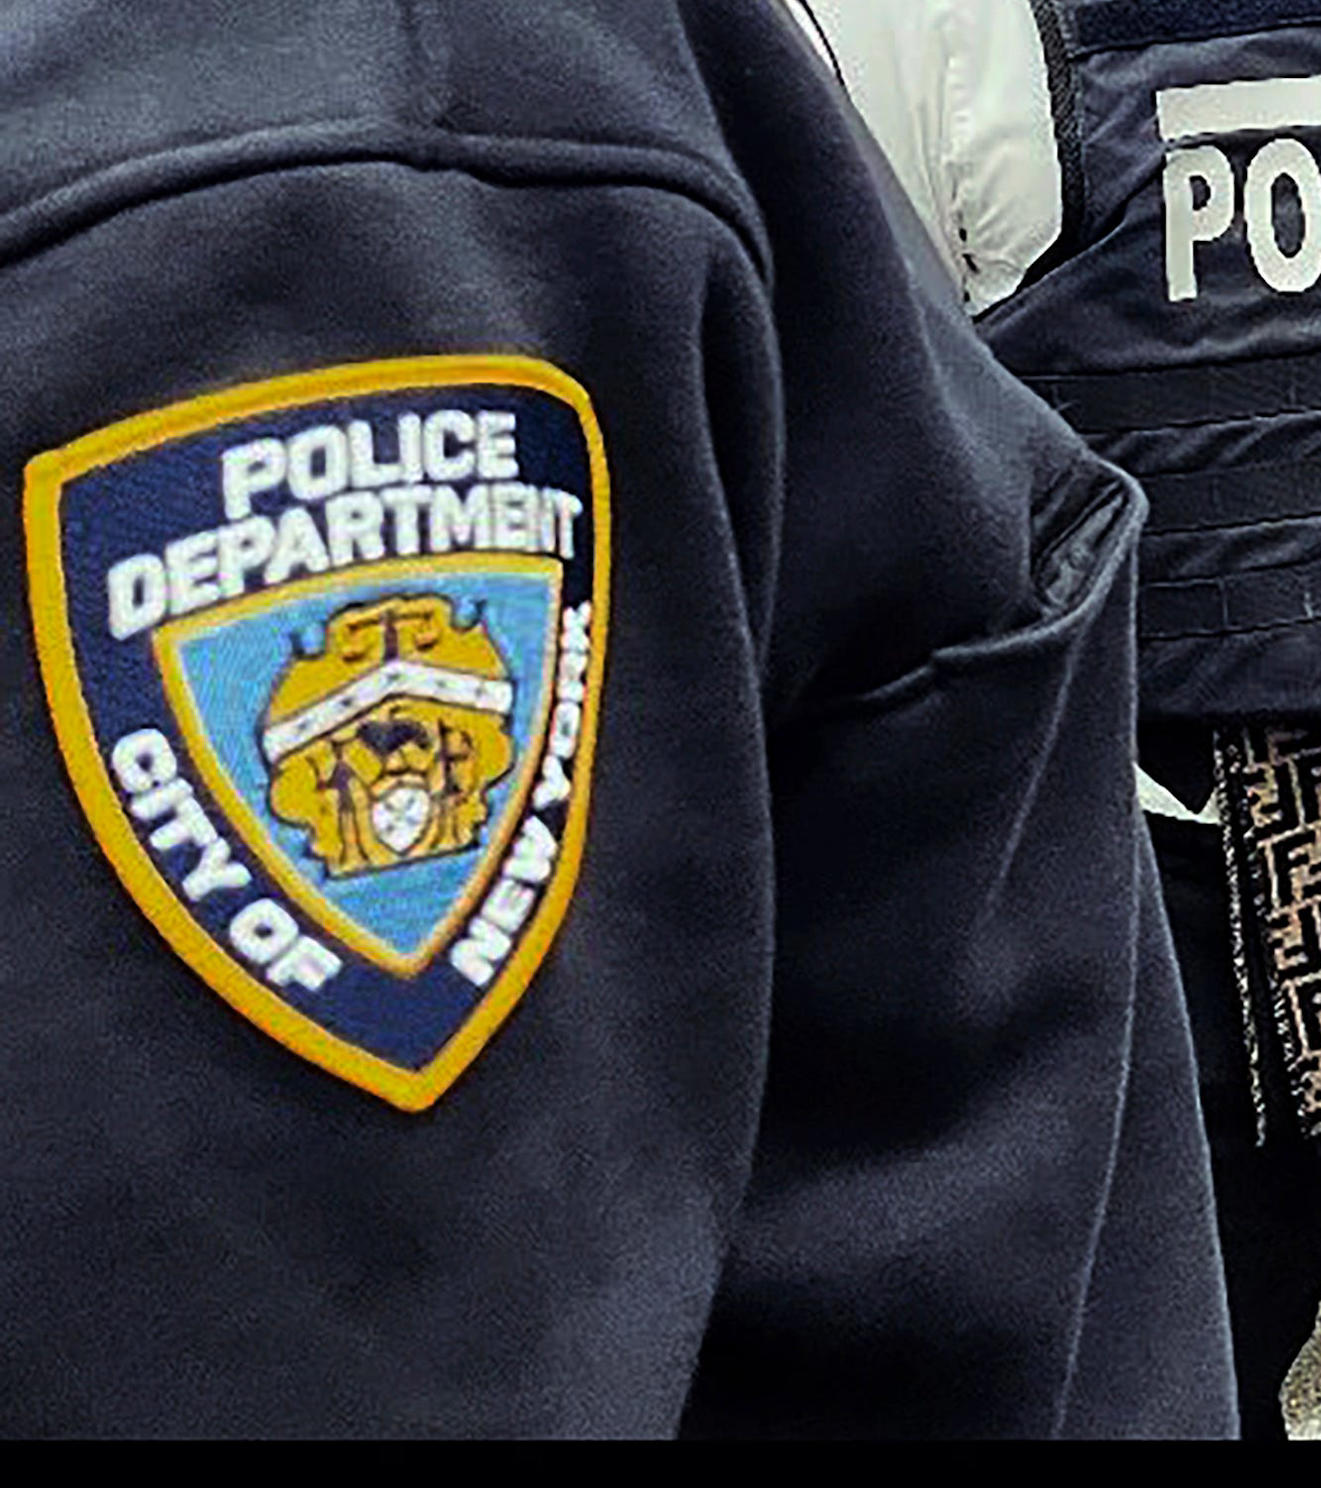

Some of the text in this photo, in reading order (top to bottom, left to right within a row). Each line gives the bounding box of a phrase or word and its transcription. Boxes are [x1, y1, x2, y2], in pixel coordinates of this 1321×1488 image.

[107, 481, 584, 641] DEPARTMENT
[221, 410, 520, 520] POLICE
[111, 727, 344, 992] CITY OF
[450, 599, 593, 988] NEW YORK
